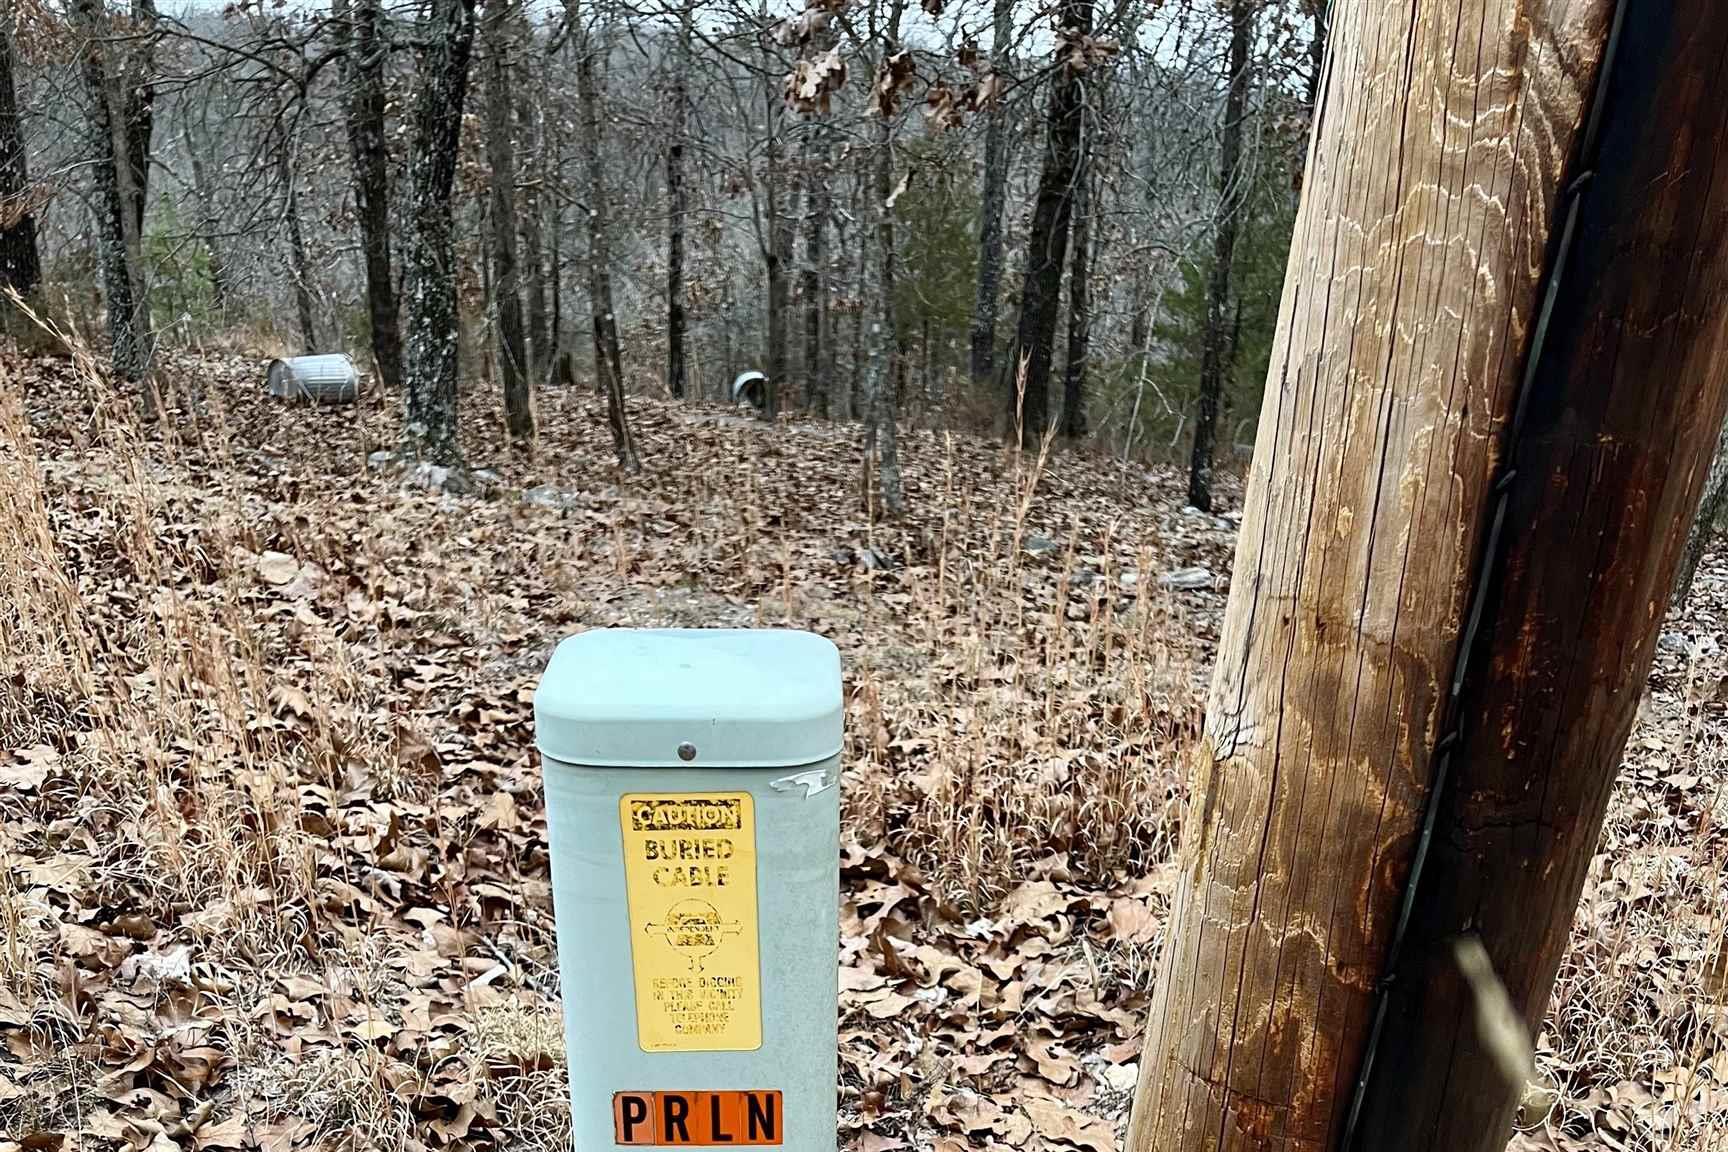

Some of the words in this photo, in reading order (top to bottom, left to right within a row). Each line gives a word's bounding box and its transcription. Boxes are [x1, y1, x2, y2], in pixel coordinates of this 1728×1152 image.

[636, 805, 739, 828] CAUTION
[645, 838, 736, 861] BURIED
[652, 866, 730, 887] CABLE
[621, 1093, 775, 1142] PRLN
